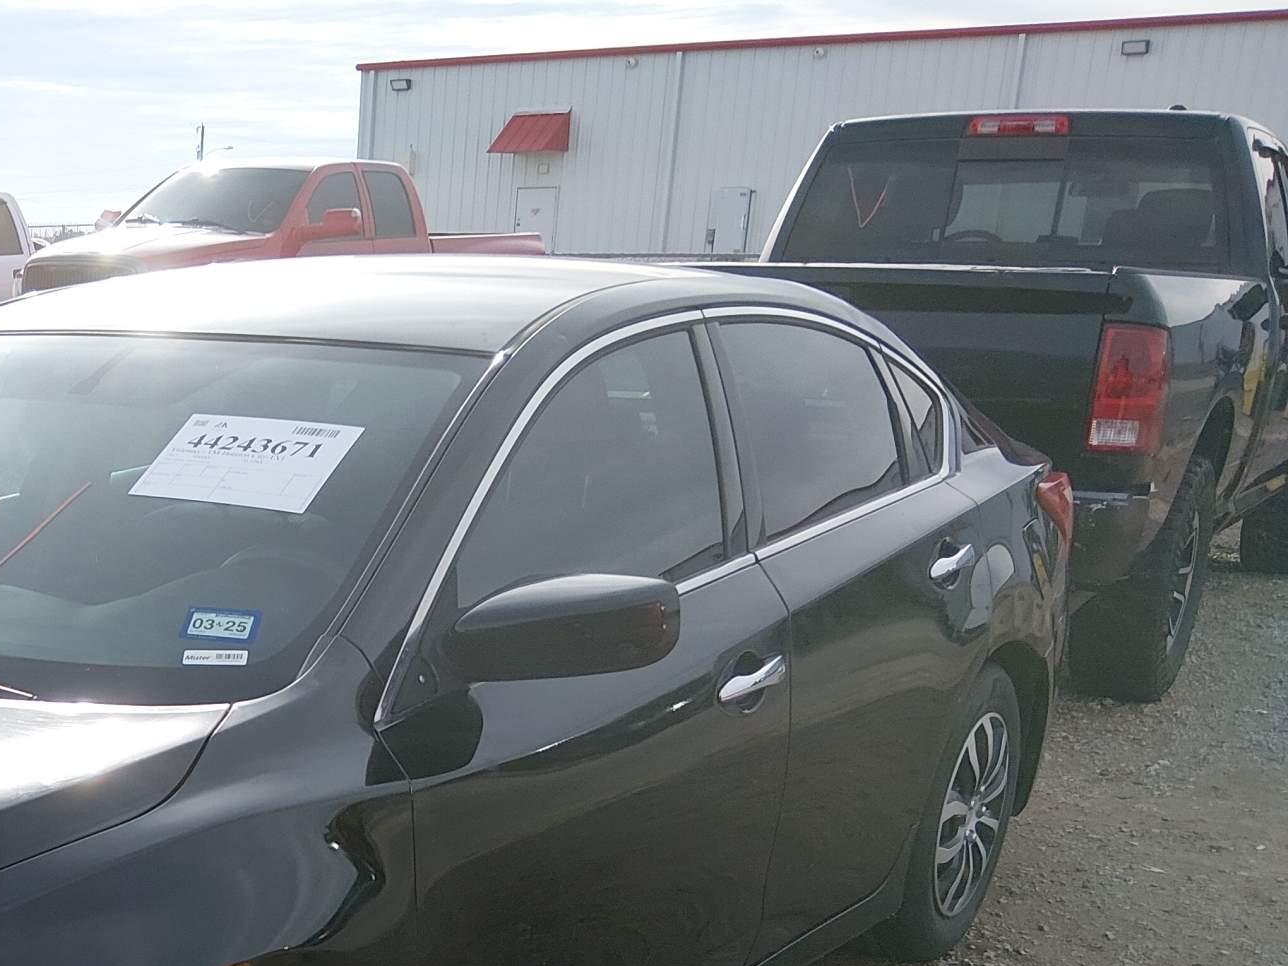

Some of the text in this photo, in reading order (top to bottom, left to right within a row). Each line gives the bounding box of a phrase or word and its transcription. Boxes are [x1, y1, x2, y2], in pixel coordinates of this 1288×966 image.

[187, 433, 324, 459] 44243671
[192, 617, 249, 633] 03 25
